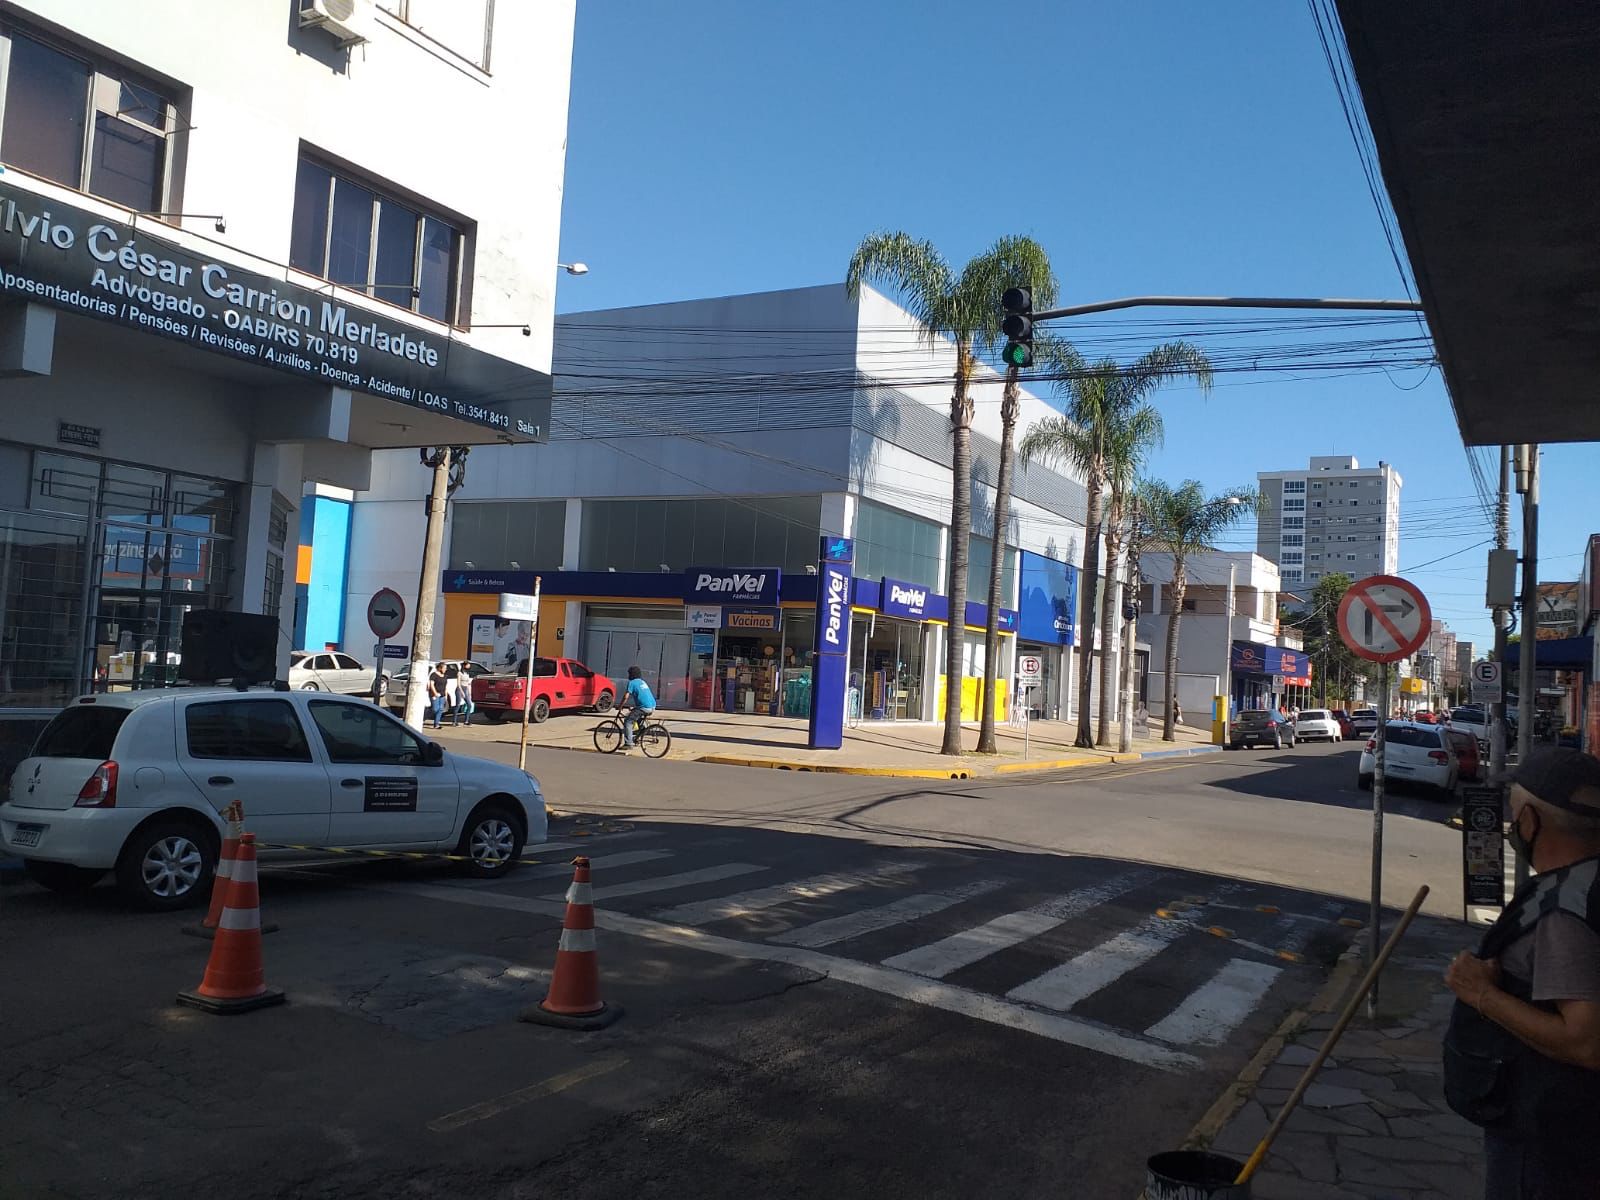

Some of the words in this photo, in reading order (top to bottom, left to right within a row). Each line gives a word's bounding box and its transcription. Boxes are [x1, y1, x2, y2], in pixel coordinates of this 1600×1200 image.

[88, 224, 193, 287] César
[201, 264, 311, 327] Carrion
[320, 301, 439, 367] Merladete
[91, 268, 206, 319] Advogado
[224, 309, 300, 347] OAB/RS
[306, 333, 358, 365] 70.819
[129, 306, 189, 336] Pensões
[200, 327, 257, 355] Revisões
[320, 361, 360, 386] Doença
[418, 390, 448, 410] LOAS
[517, 419, 534, 435] Sala
[535, 426, 540, 437] 1
[732, 615, 771, 627] Vacinas
[1482, 666, 1492, 678] E
